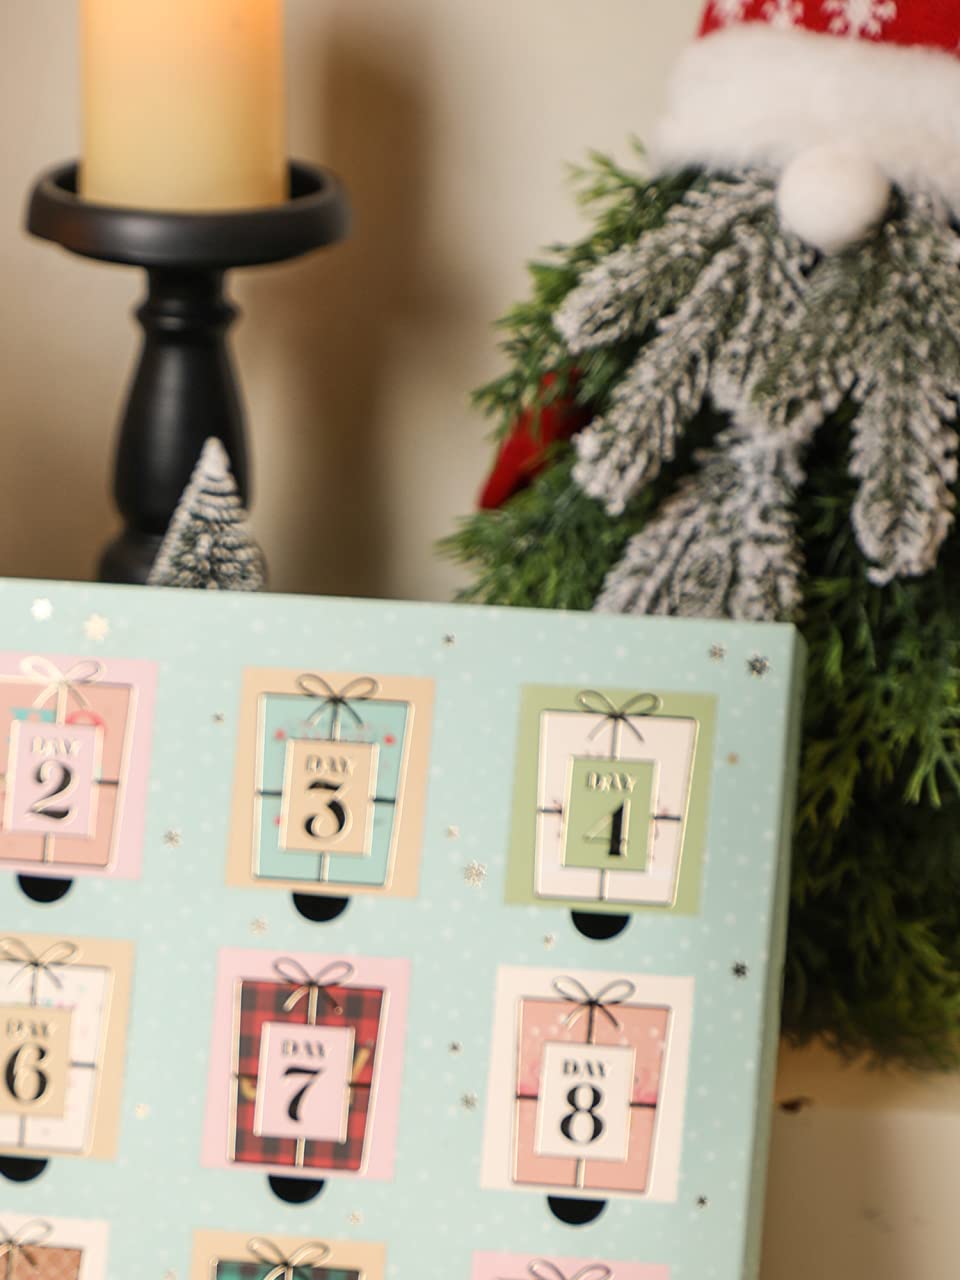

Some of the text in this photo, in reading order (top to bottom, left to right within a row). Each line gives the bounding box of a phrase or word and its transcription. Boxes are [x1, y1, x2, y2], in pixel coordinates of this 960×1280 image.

[27, 759, 77, 821] 2
[304, 778, 352, 840] 3
[583, 799, 631, 857] 4
[3, 1042, 50, 1105] 6
[283, 1064, 323, 1123] 7
[562, 1058, 610, 1078] DAY
[559, 1082, 606, 1144] 8
